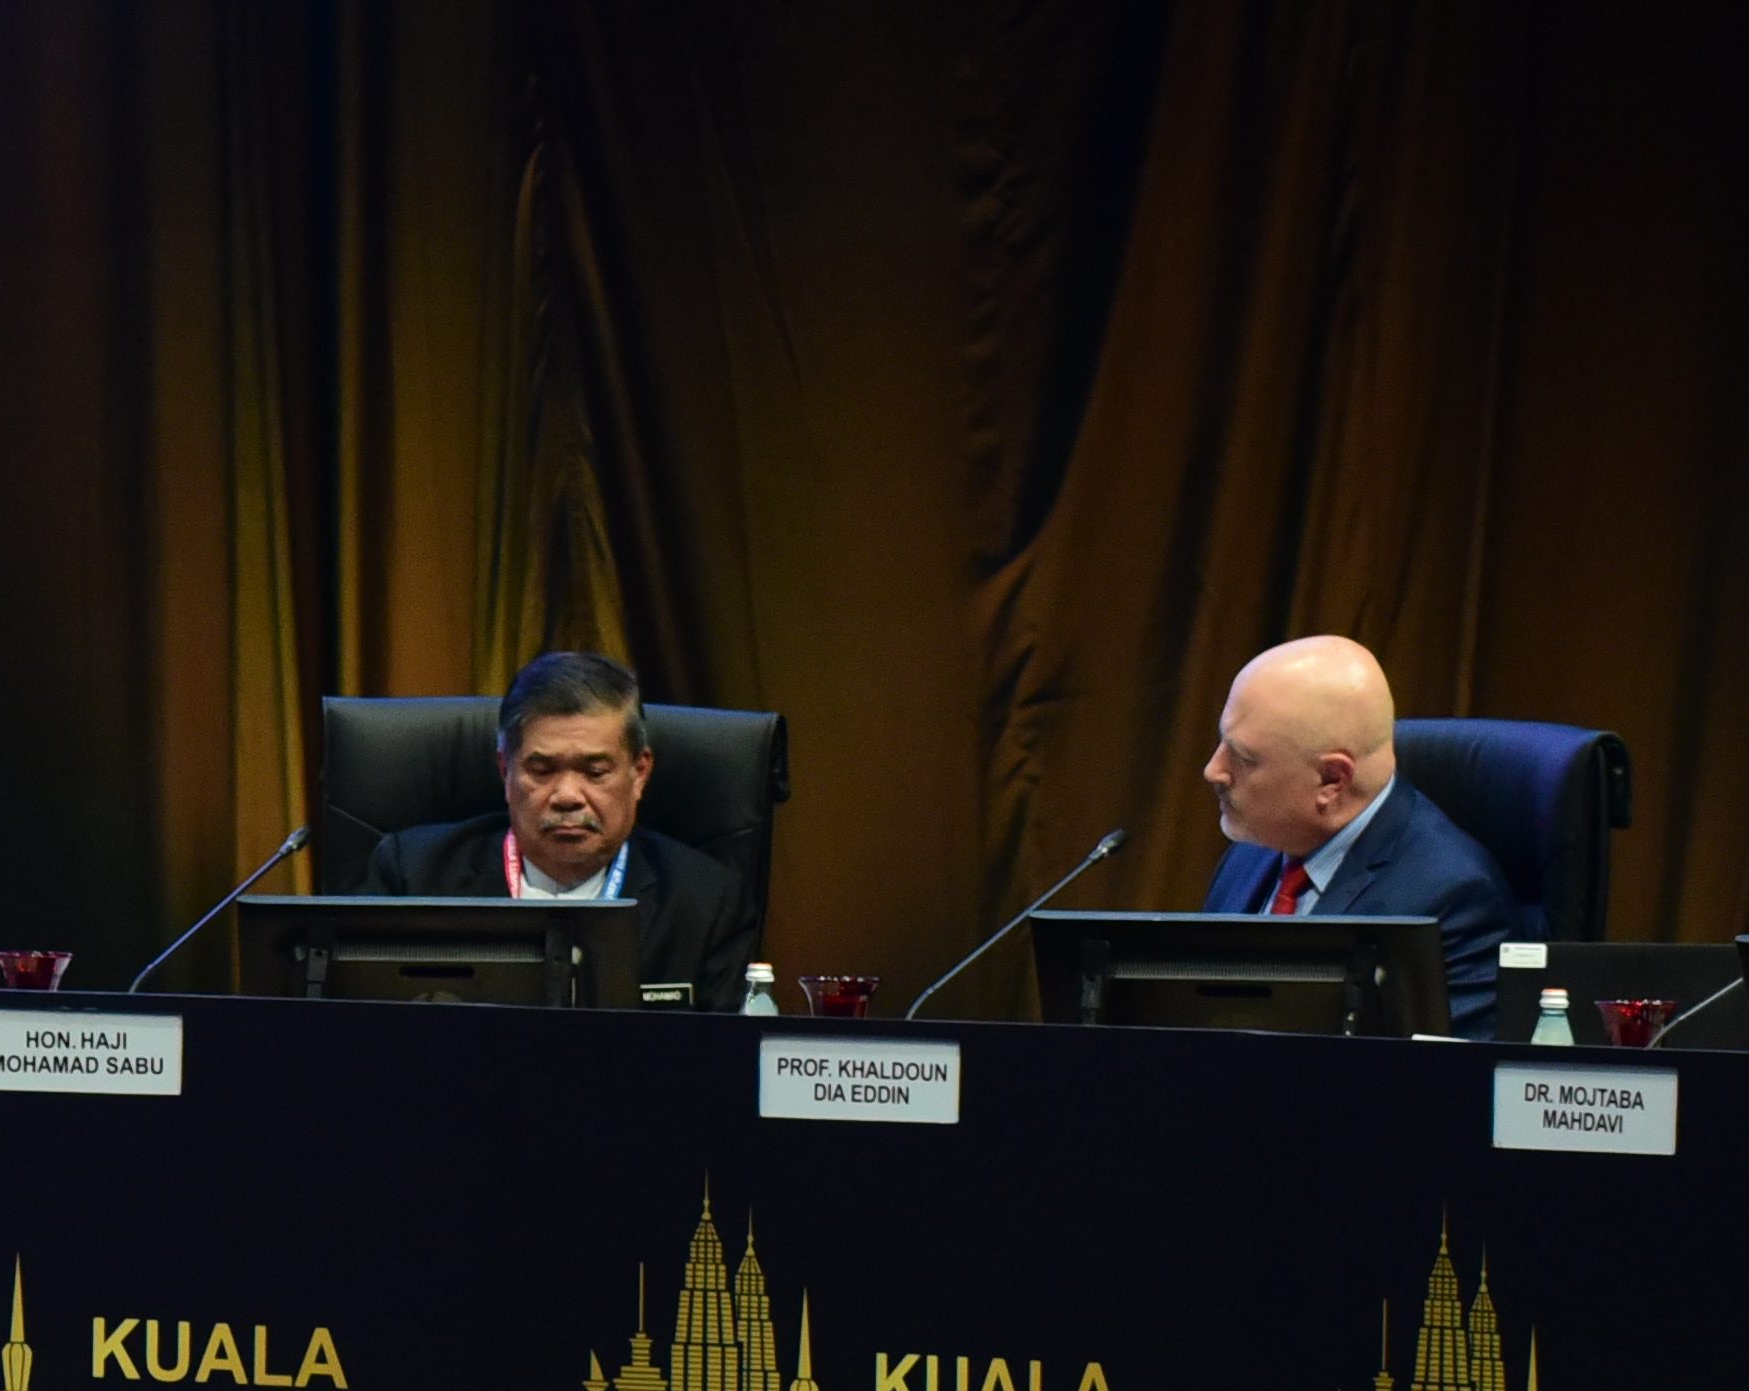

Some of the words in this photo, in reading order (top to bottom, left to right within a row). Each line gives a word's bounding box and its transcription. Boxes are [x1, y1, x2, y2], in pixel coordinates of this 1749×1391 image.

[26, 1030, 76, 1049] HON.
[81, 1031, 128, 1051] HAJI
[106, 1056, 165, 1076] SABU
[777, 1056, 833, 1077] PROF.
[838, 1058, 948, 1082] KHALDOUN
[813, 1083, 846, 1103] DIA
[851, 1084, 910, 1105] EDDIN
[1524, 1082, 1554, 1103] DR.
[1558, 1084, 1645, 1111] MOJTABA
[1542, 1109, 1624, 1135] MAHDAVI
[91, 1317, 347, 1389] KUALA
